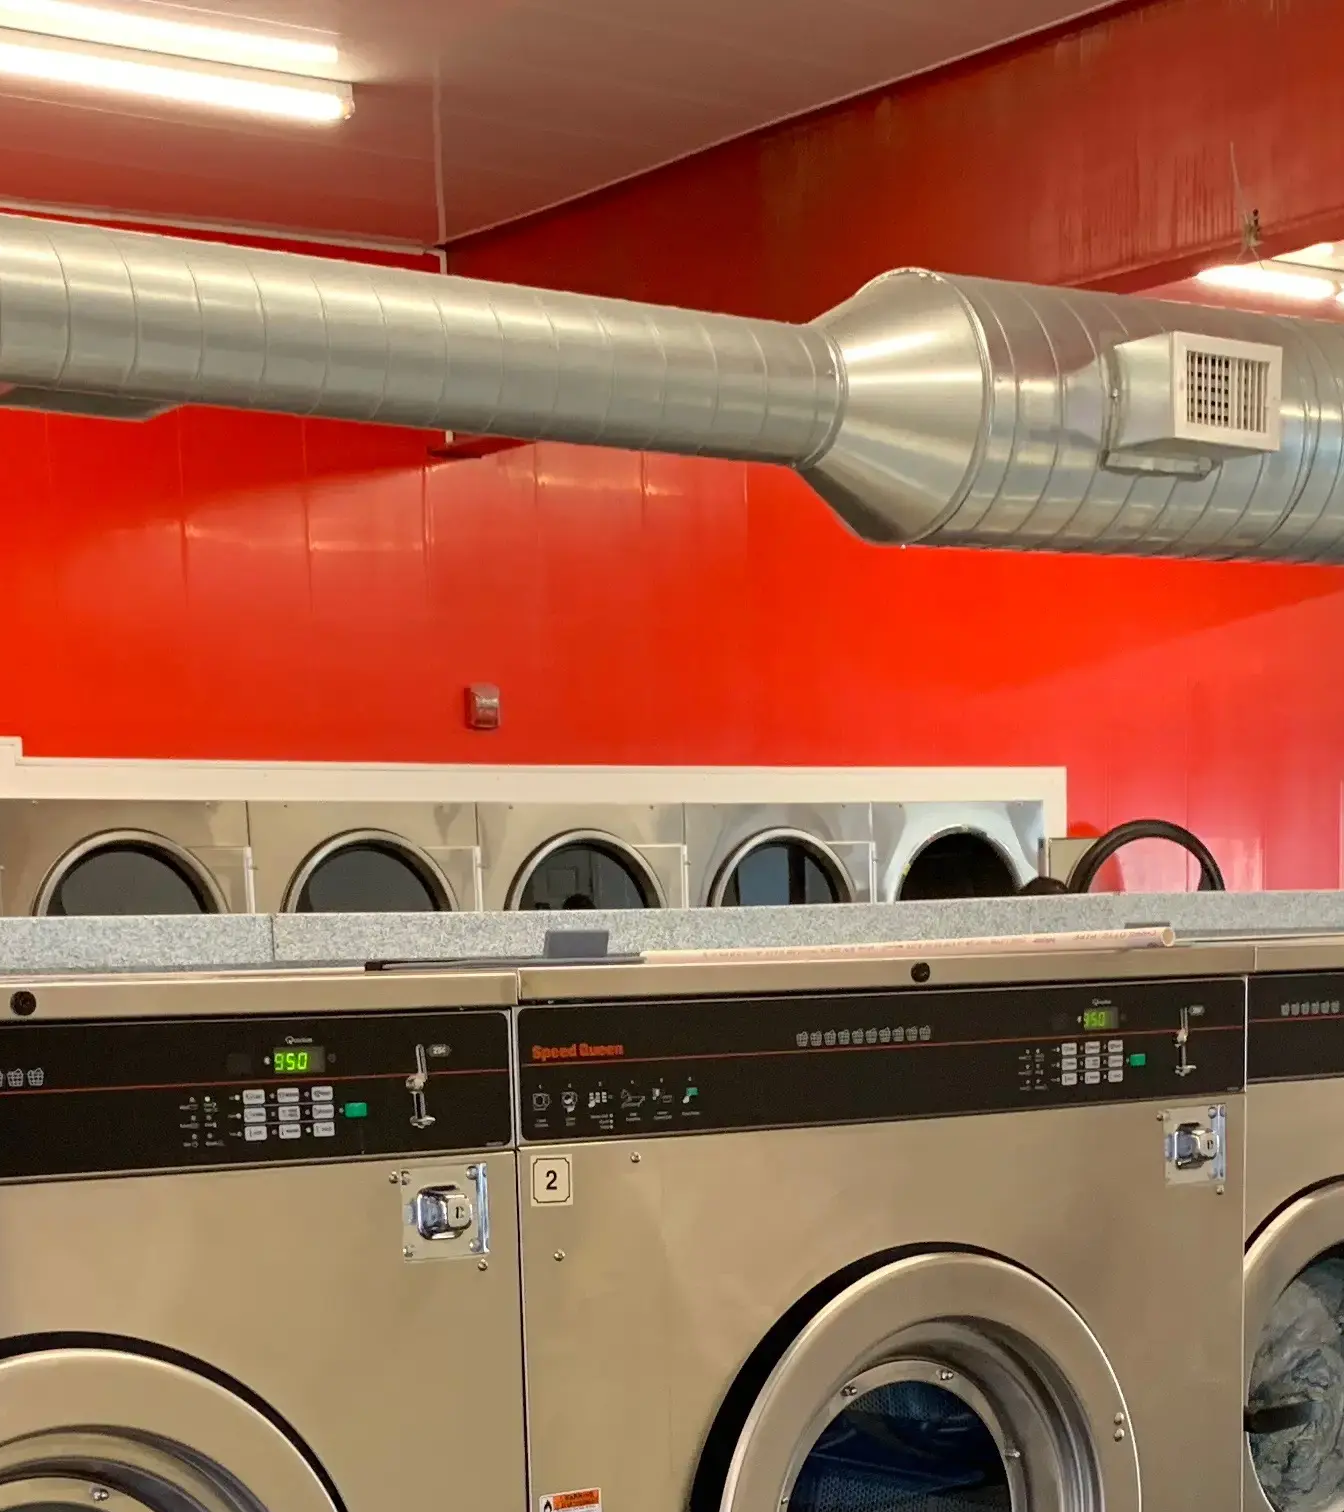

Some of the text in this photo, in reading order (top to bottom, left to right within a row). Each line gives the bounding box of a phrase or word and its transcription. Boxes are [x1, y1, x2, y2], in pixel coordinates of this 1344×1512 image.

[532, 1042, 624, 1061] Speed Queen
[274, 1052, 308, 1071] 950
[545, 1169, 558, 1191] 2
